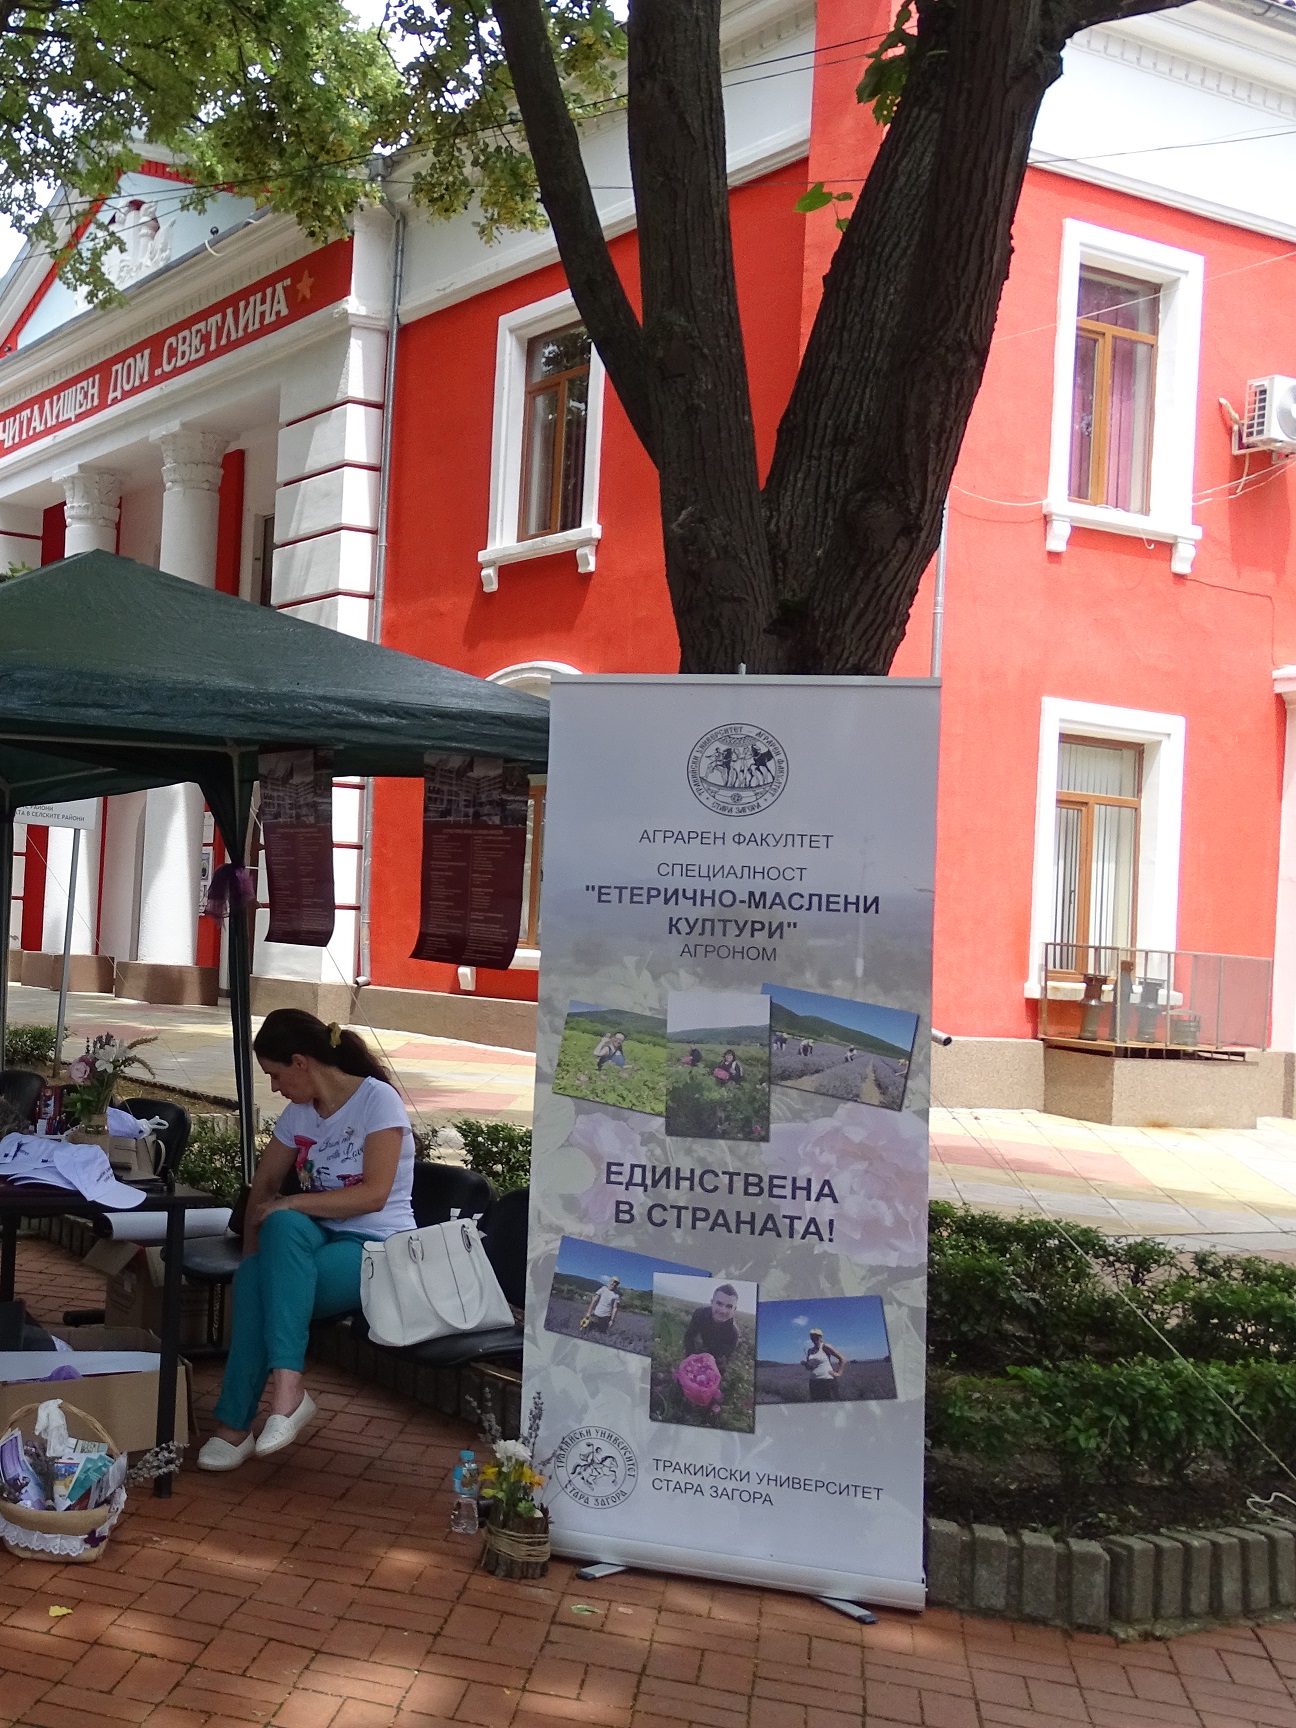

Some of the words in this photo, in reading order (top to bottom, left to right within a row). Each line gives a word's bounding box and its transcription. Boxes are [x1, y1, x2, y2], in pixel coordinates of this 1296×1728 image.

[108, 347, 150, 404] ДОМ
[638, 828, 726, 846] АГРАРЕН
[732, 831, 835, 850] ФАКУЛТЕТ
[657, 862, 808, 882] СПЕЦИАЛНОСТ
[585, 884, 881, 915] "ЕТЕРИЧНО-МАСЛЕНИ
[667, 916, 798, 940] КУЛТУРИ"
[680, 943, 777, 962] АГРОНОМ
[605, 1161, 839, 1204] ЕДИНСТВЕНА
[614, 1200, 635, 1224] В
[647, 1202, 835, 1243] СТРАНАТА!
[595, 1429, 636, 1478] УНИВЕРСИТЕТ
[652, 1458, 751, 1484] ТРАКИЙСКИ
[755, 1472, 884, 1501] УНИВЕРСИТЕТ
[652, 1478, 705, 1498] СТАРА
[709, 1484, 774, 1507] ЗАГОРА
[594, 1489, 628, 1507] ЗАГОРА
